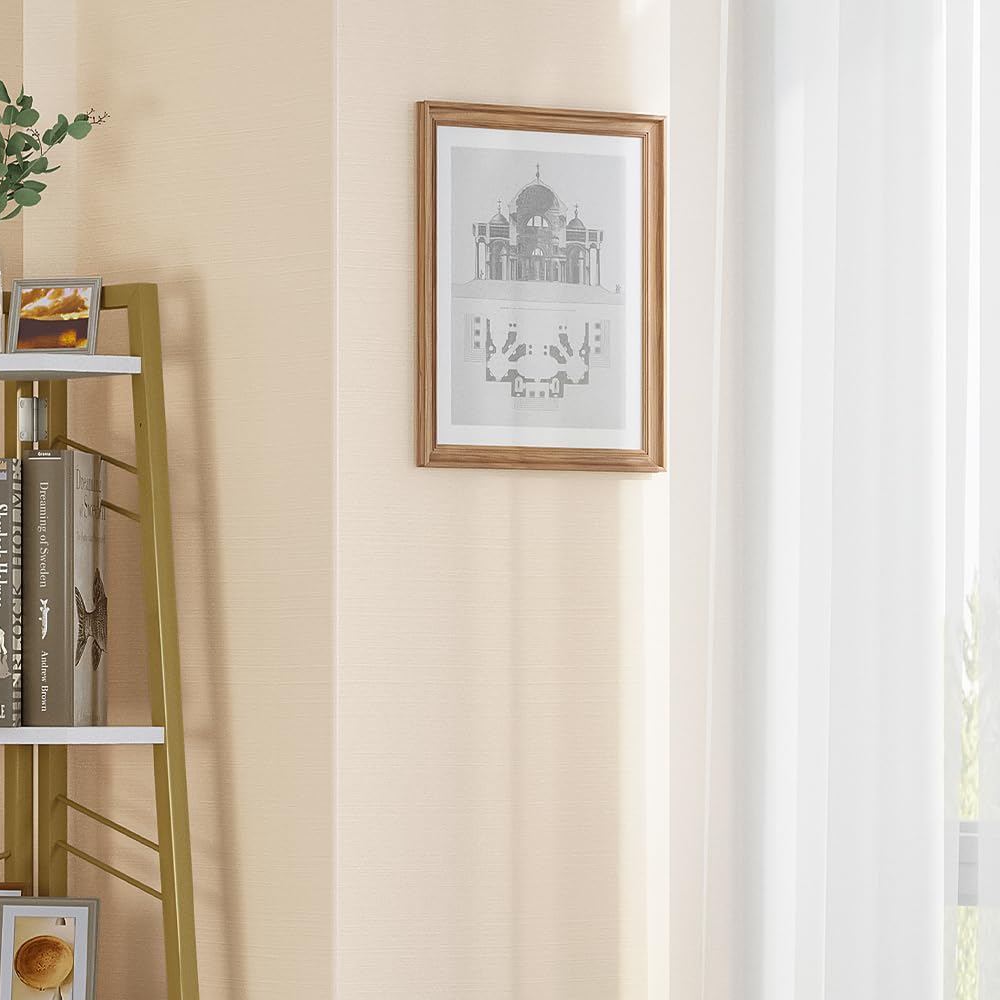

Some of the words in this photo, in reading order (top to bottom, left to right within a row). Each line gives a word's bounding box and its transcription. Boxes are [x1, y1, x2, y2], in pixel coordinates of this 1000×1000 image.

[38, 481, 50, 533] Dreaming
[39, 534, 50, 546] of
[39, 547, 50, 588] Sweden
[40, 650, 49, 683] Andrew
[40, 685, 49, 712] Brown
